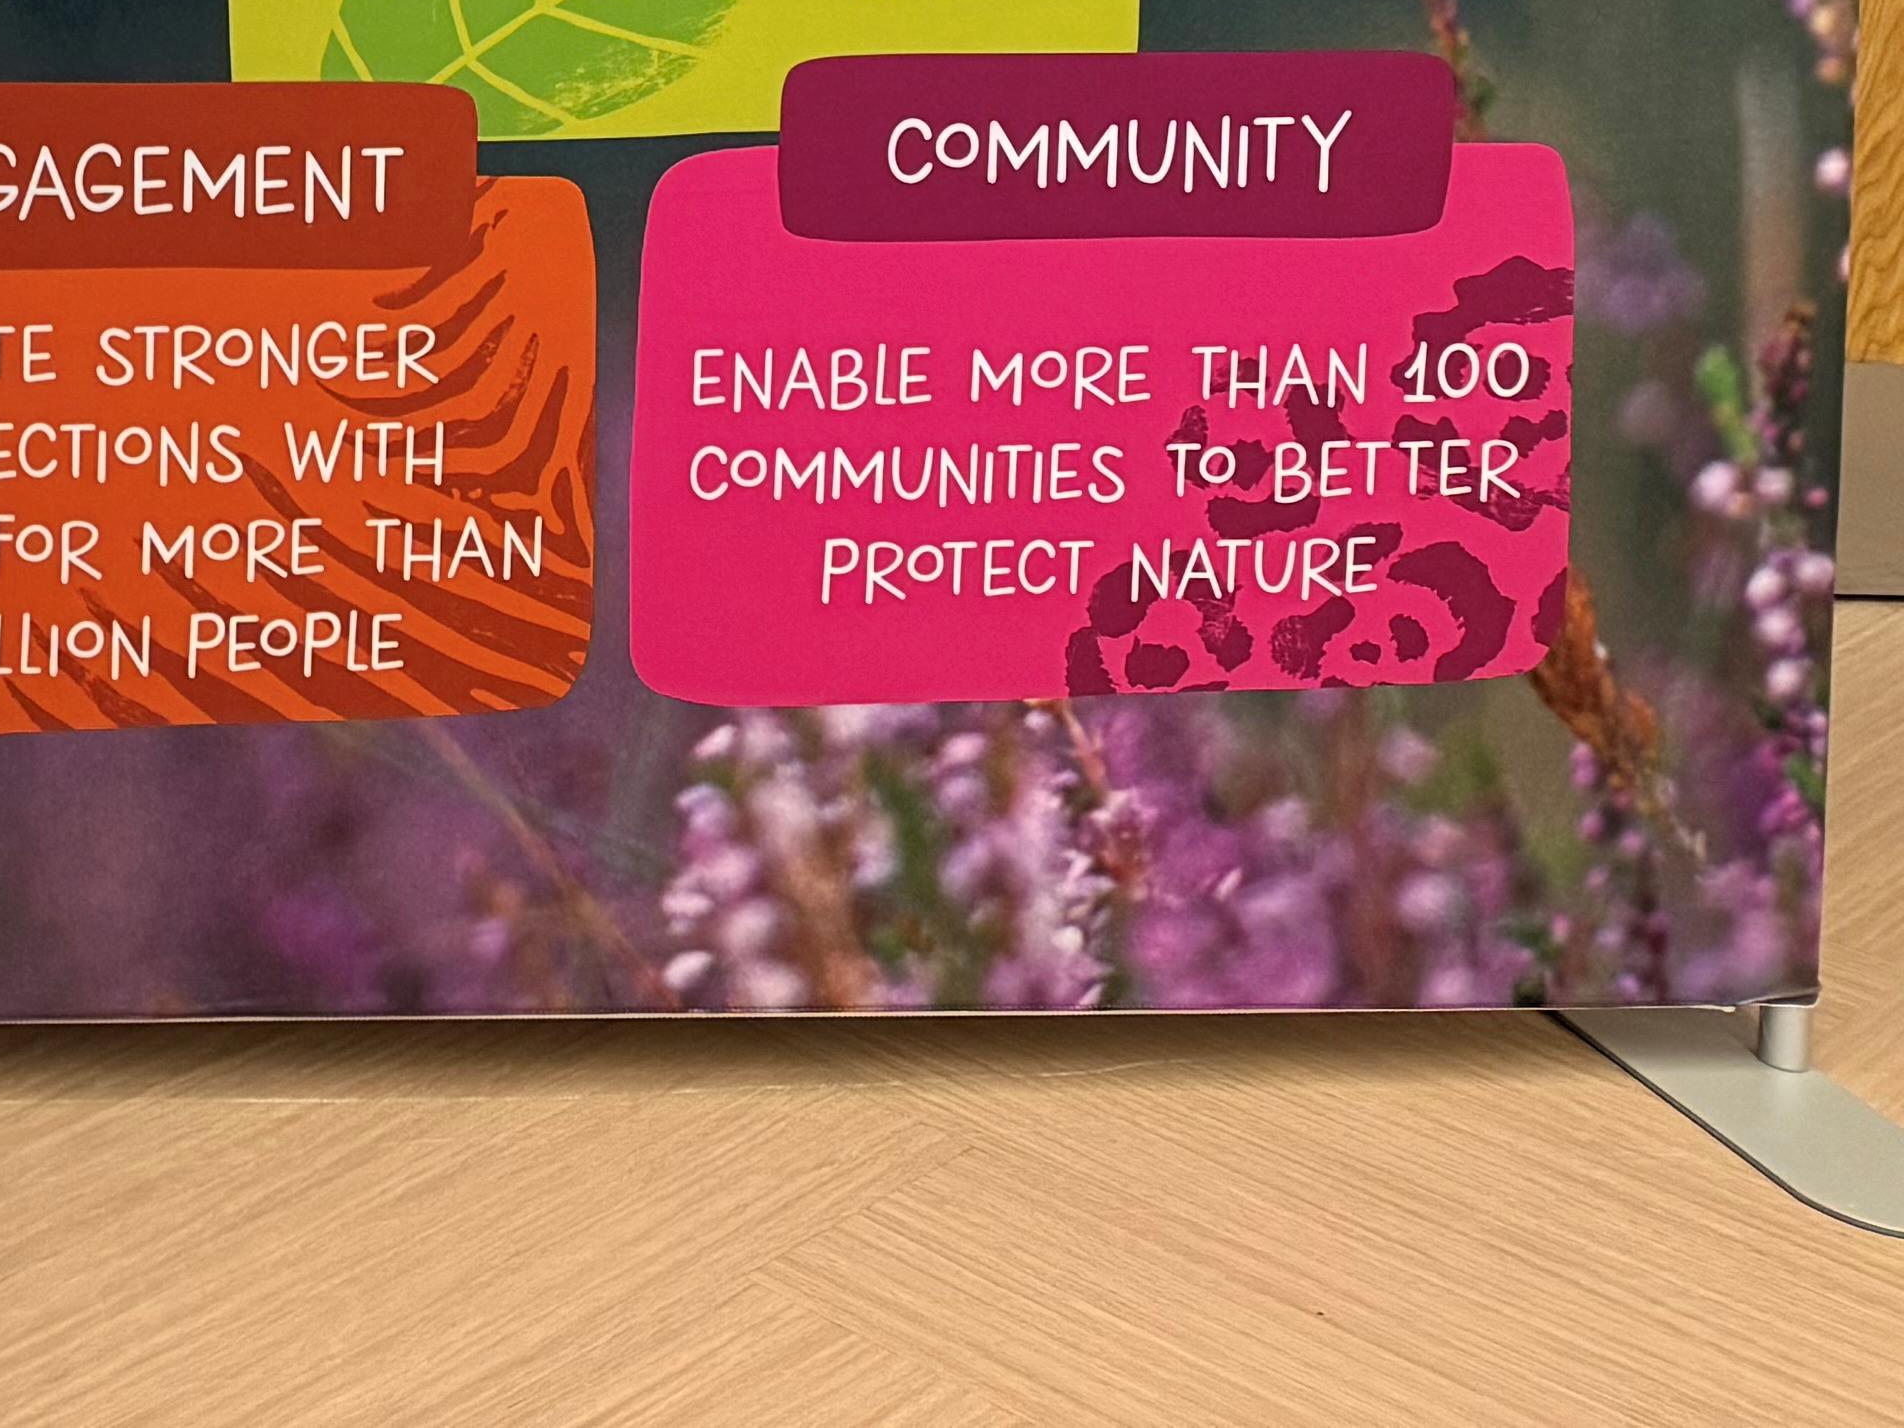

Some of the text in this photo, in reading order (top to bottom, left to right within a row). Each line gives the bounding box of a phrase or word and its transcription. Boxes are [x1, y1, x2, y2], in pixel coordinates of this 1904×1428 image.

[888, 110, 1351, 192] COMMUNITY
[97, 322, 438, 389] STRONGER
[694, 342, 1529, 412] ENABLE MORE THAN 100
[285, 420, 443, 485] WITH
[691, 439, 1520, 507] COMMUNITIES TO BETTER
[142, 519, 324, 582] MORE
[366, 517, 542, 581] THAN
[822, 537, 1377, 604] PROTECT NATURE
[189, 610, 403, 678] PEOPLE
